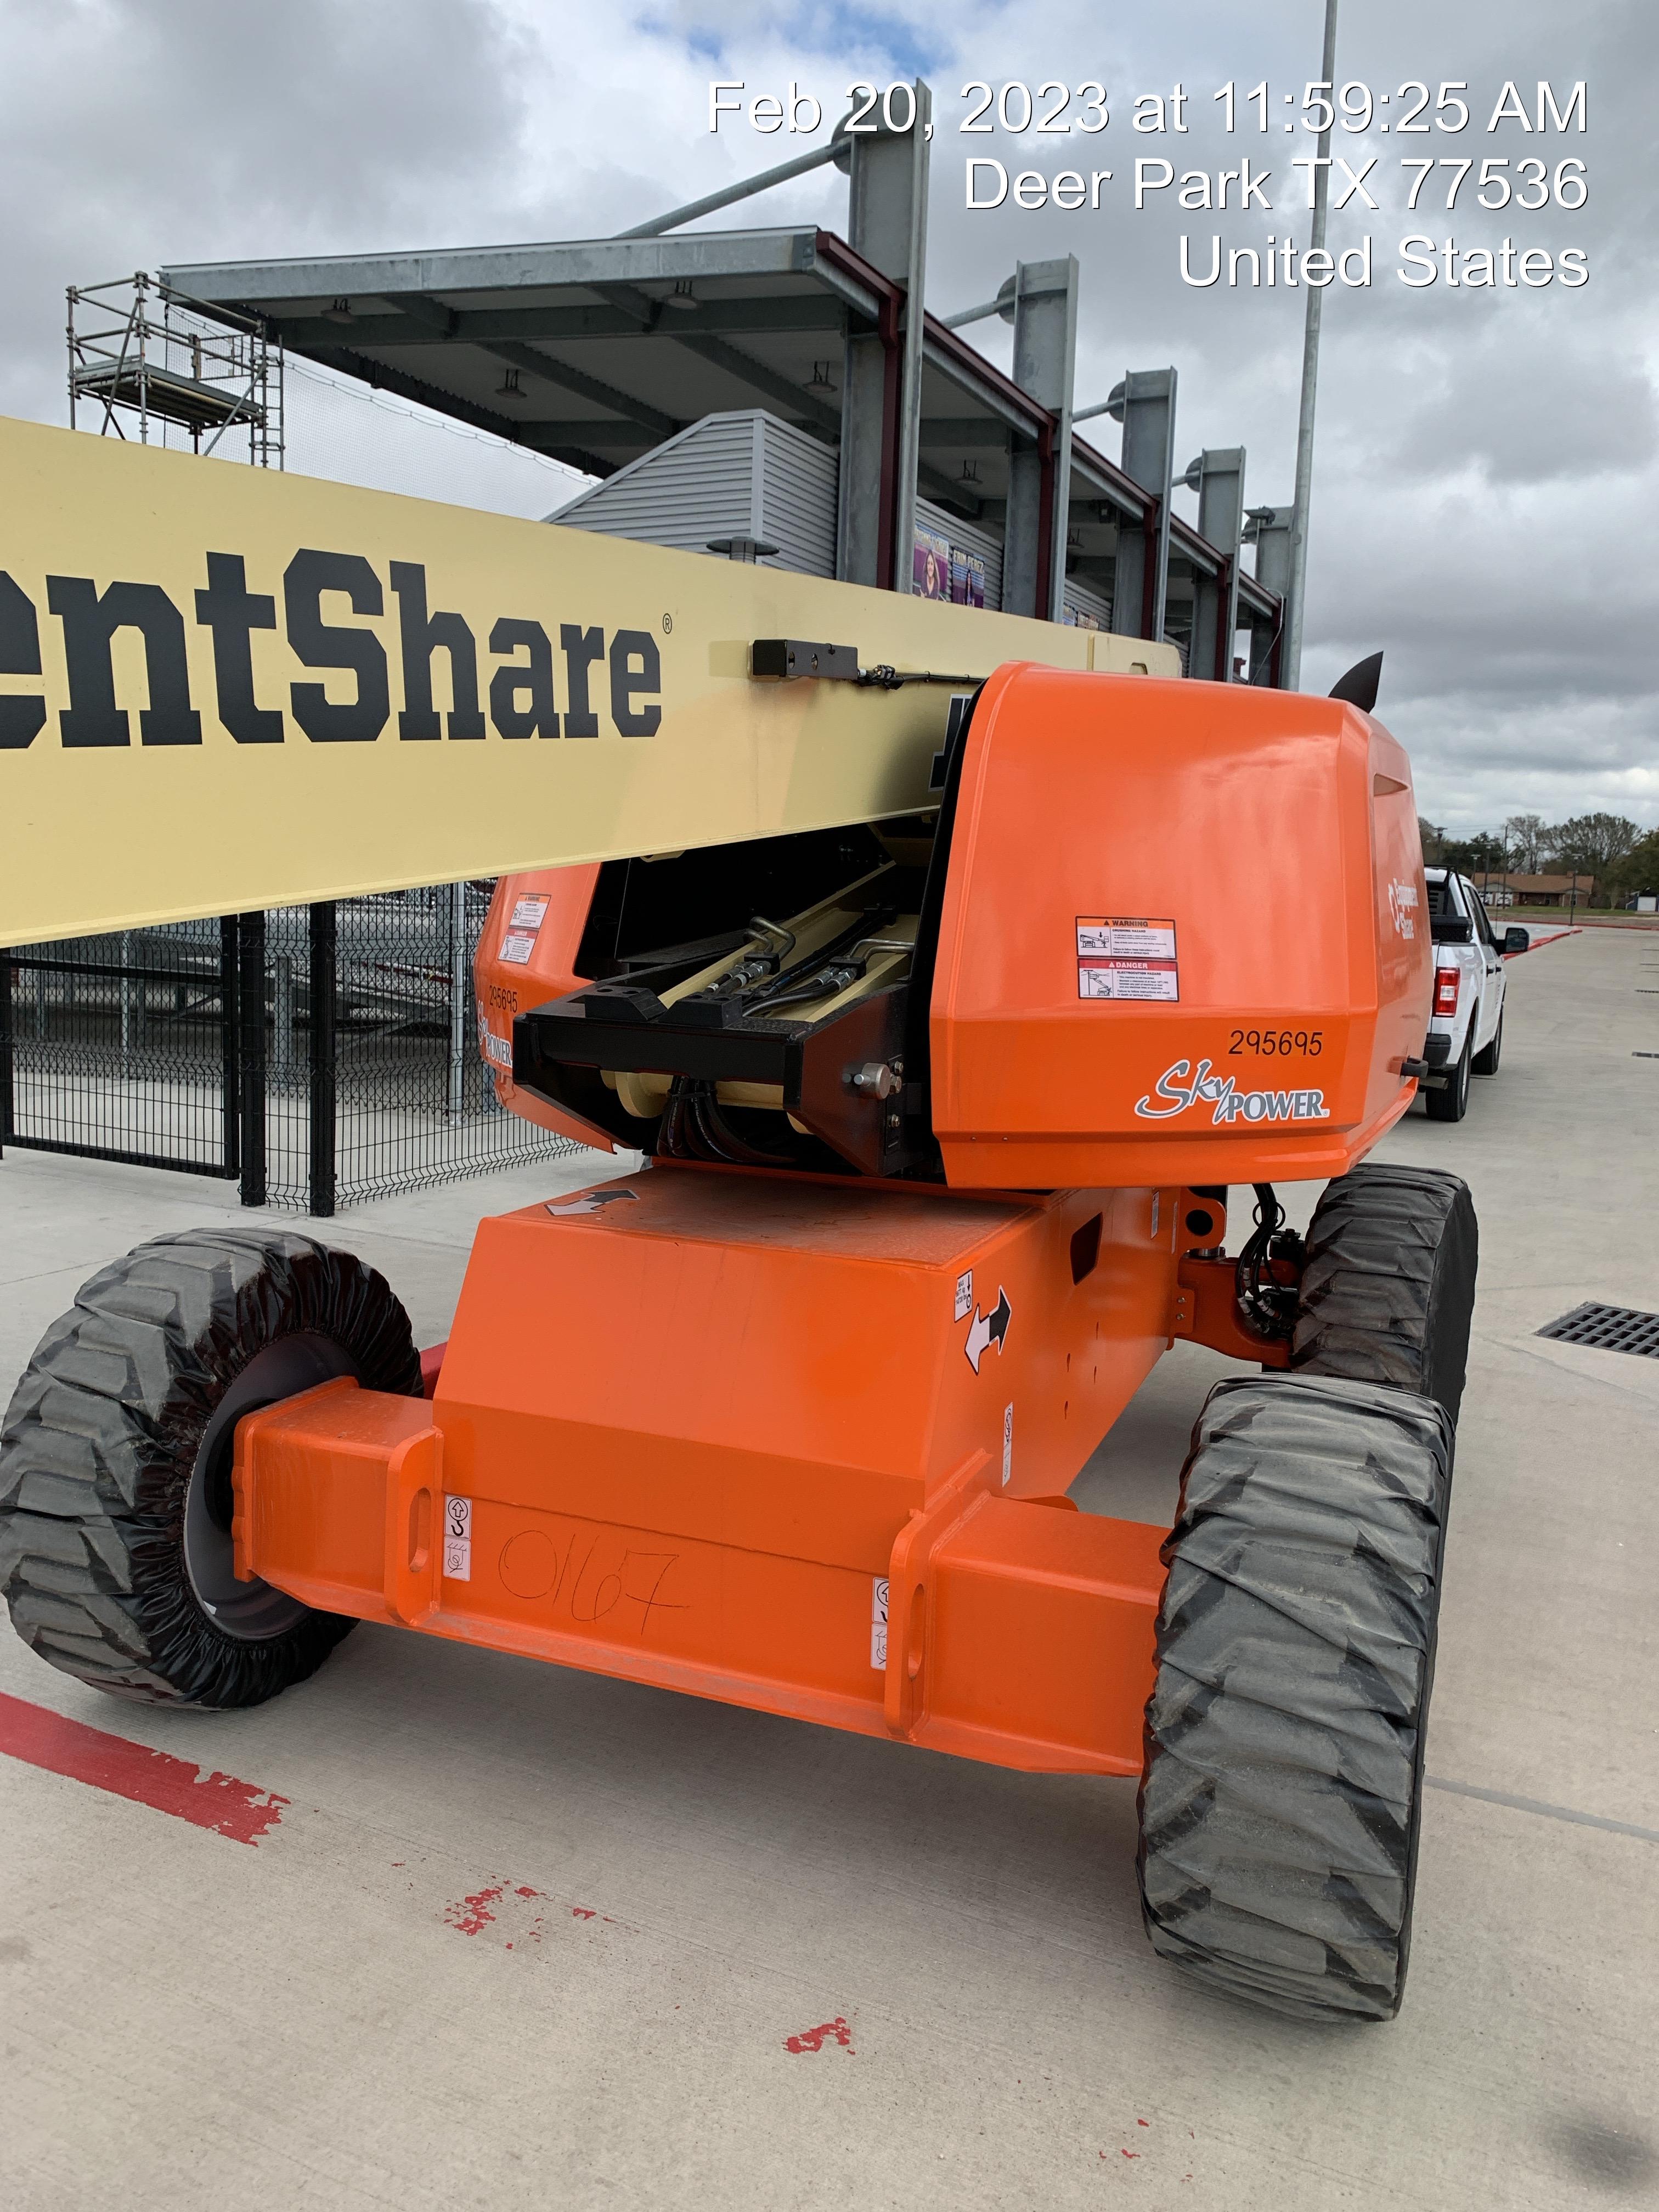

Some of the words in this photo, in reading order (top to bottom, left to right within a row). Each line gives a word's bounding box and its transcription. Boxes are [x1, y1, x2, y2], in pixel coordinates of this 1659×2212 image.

[953, 549, 967, 566] ERIN
[967, 556, 985, 574] PEREZ
[489, 985, 518, 1013] 295695
[1228, 1030, 1323, 1056] 295695
